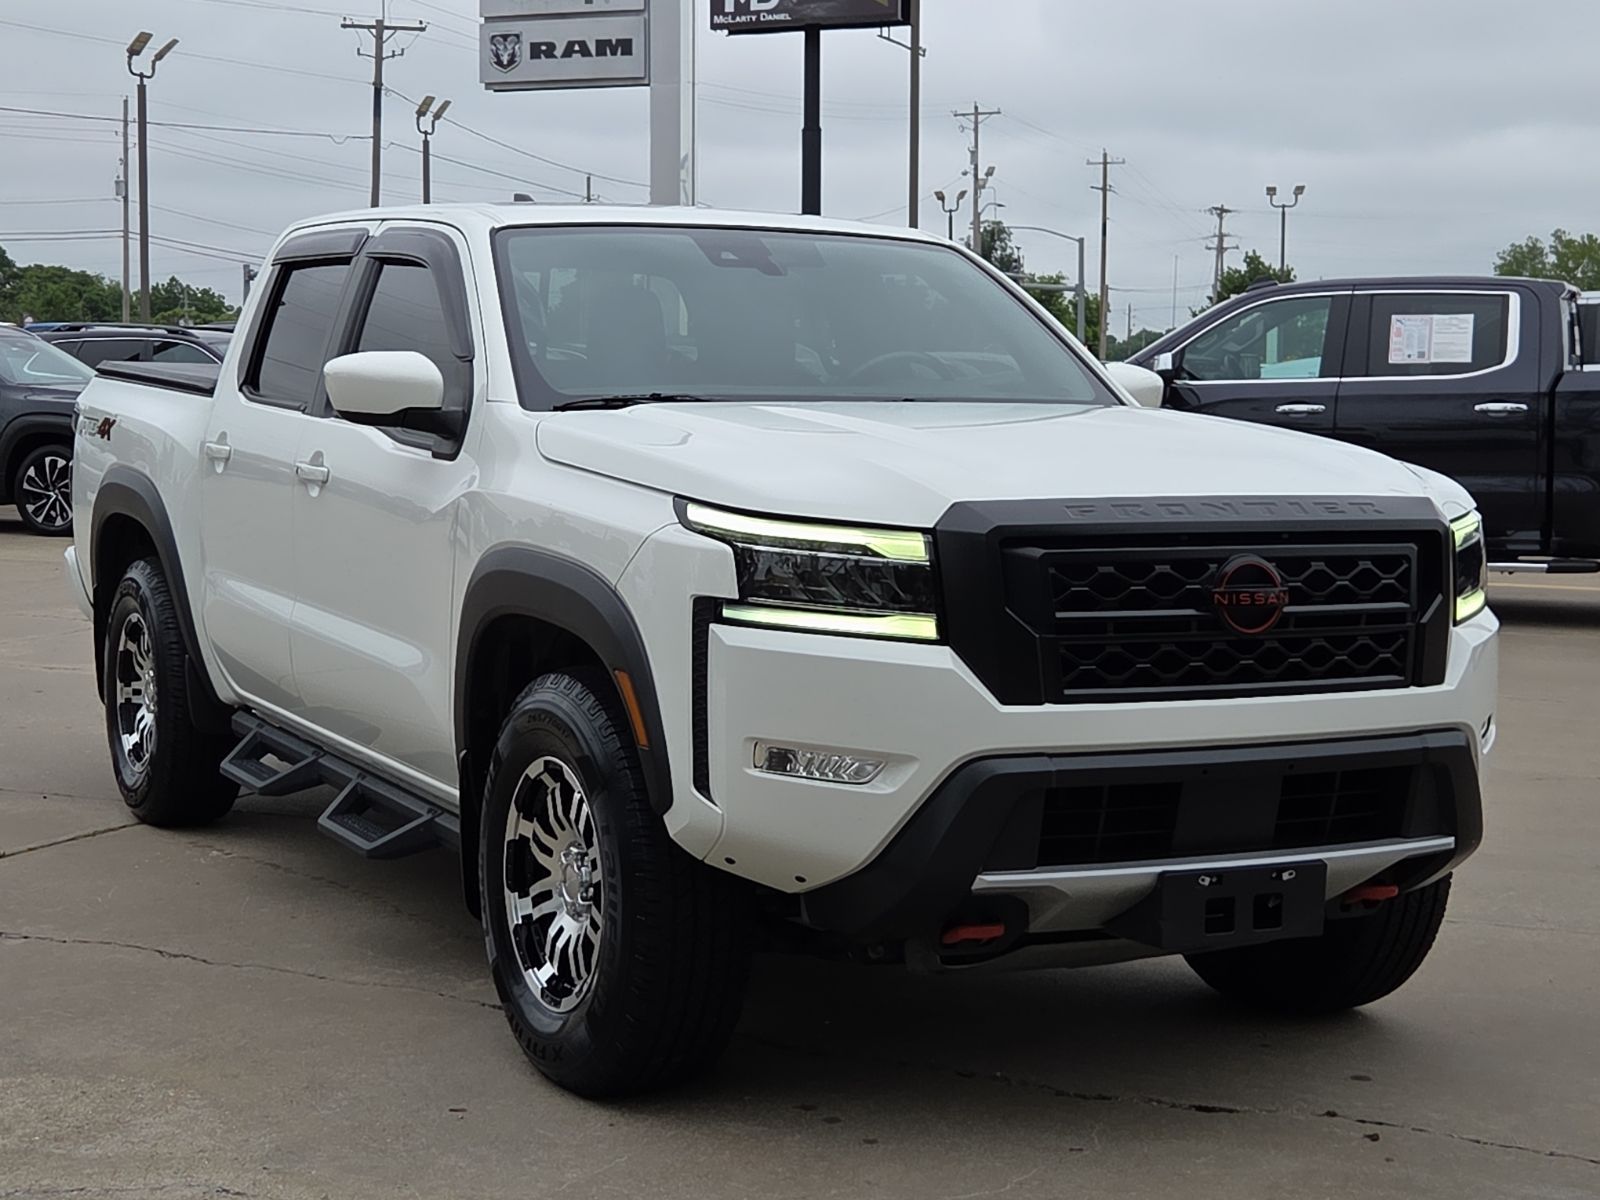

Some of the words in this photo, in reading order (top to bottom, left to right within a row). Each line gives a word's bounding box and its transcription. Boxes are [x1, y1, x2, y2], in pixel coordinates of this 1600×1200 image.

[760, 12, 792, 21] DANIEL
[529, 38, 634, 60] RAM
[1064, 501, 1385, 518] FRONTIER
[1213, 592, 1289, 605] NISSAN
